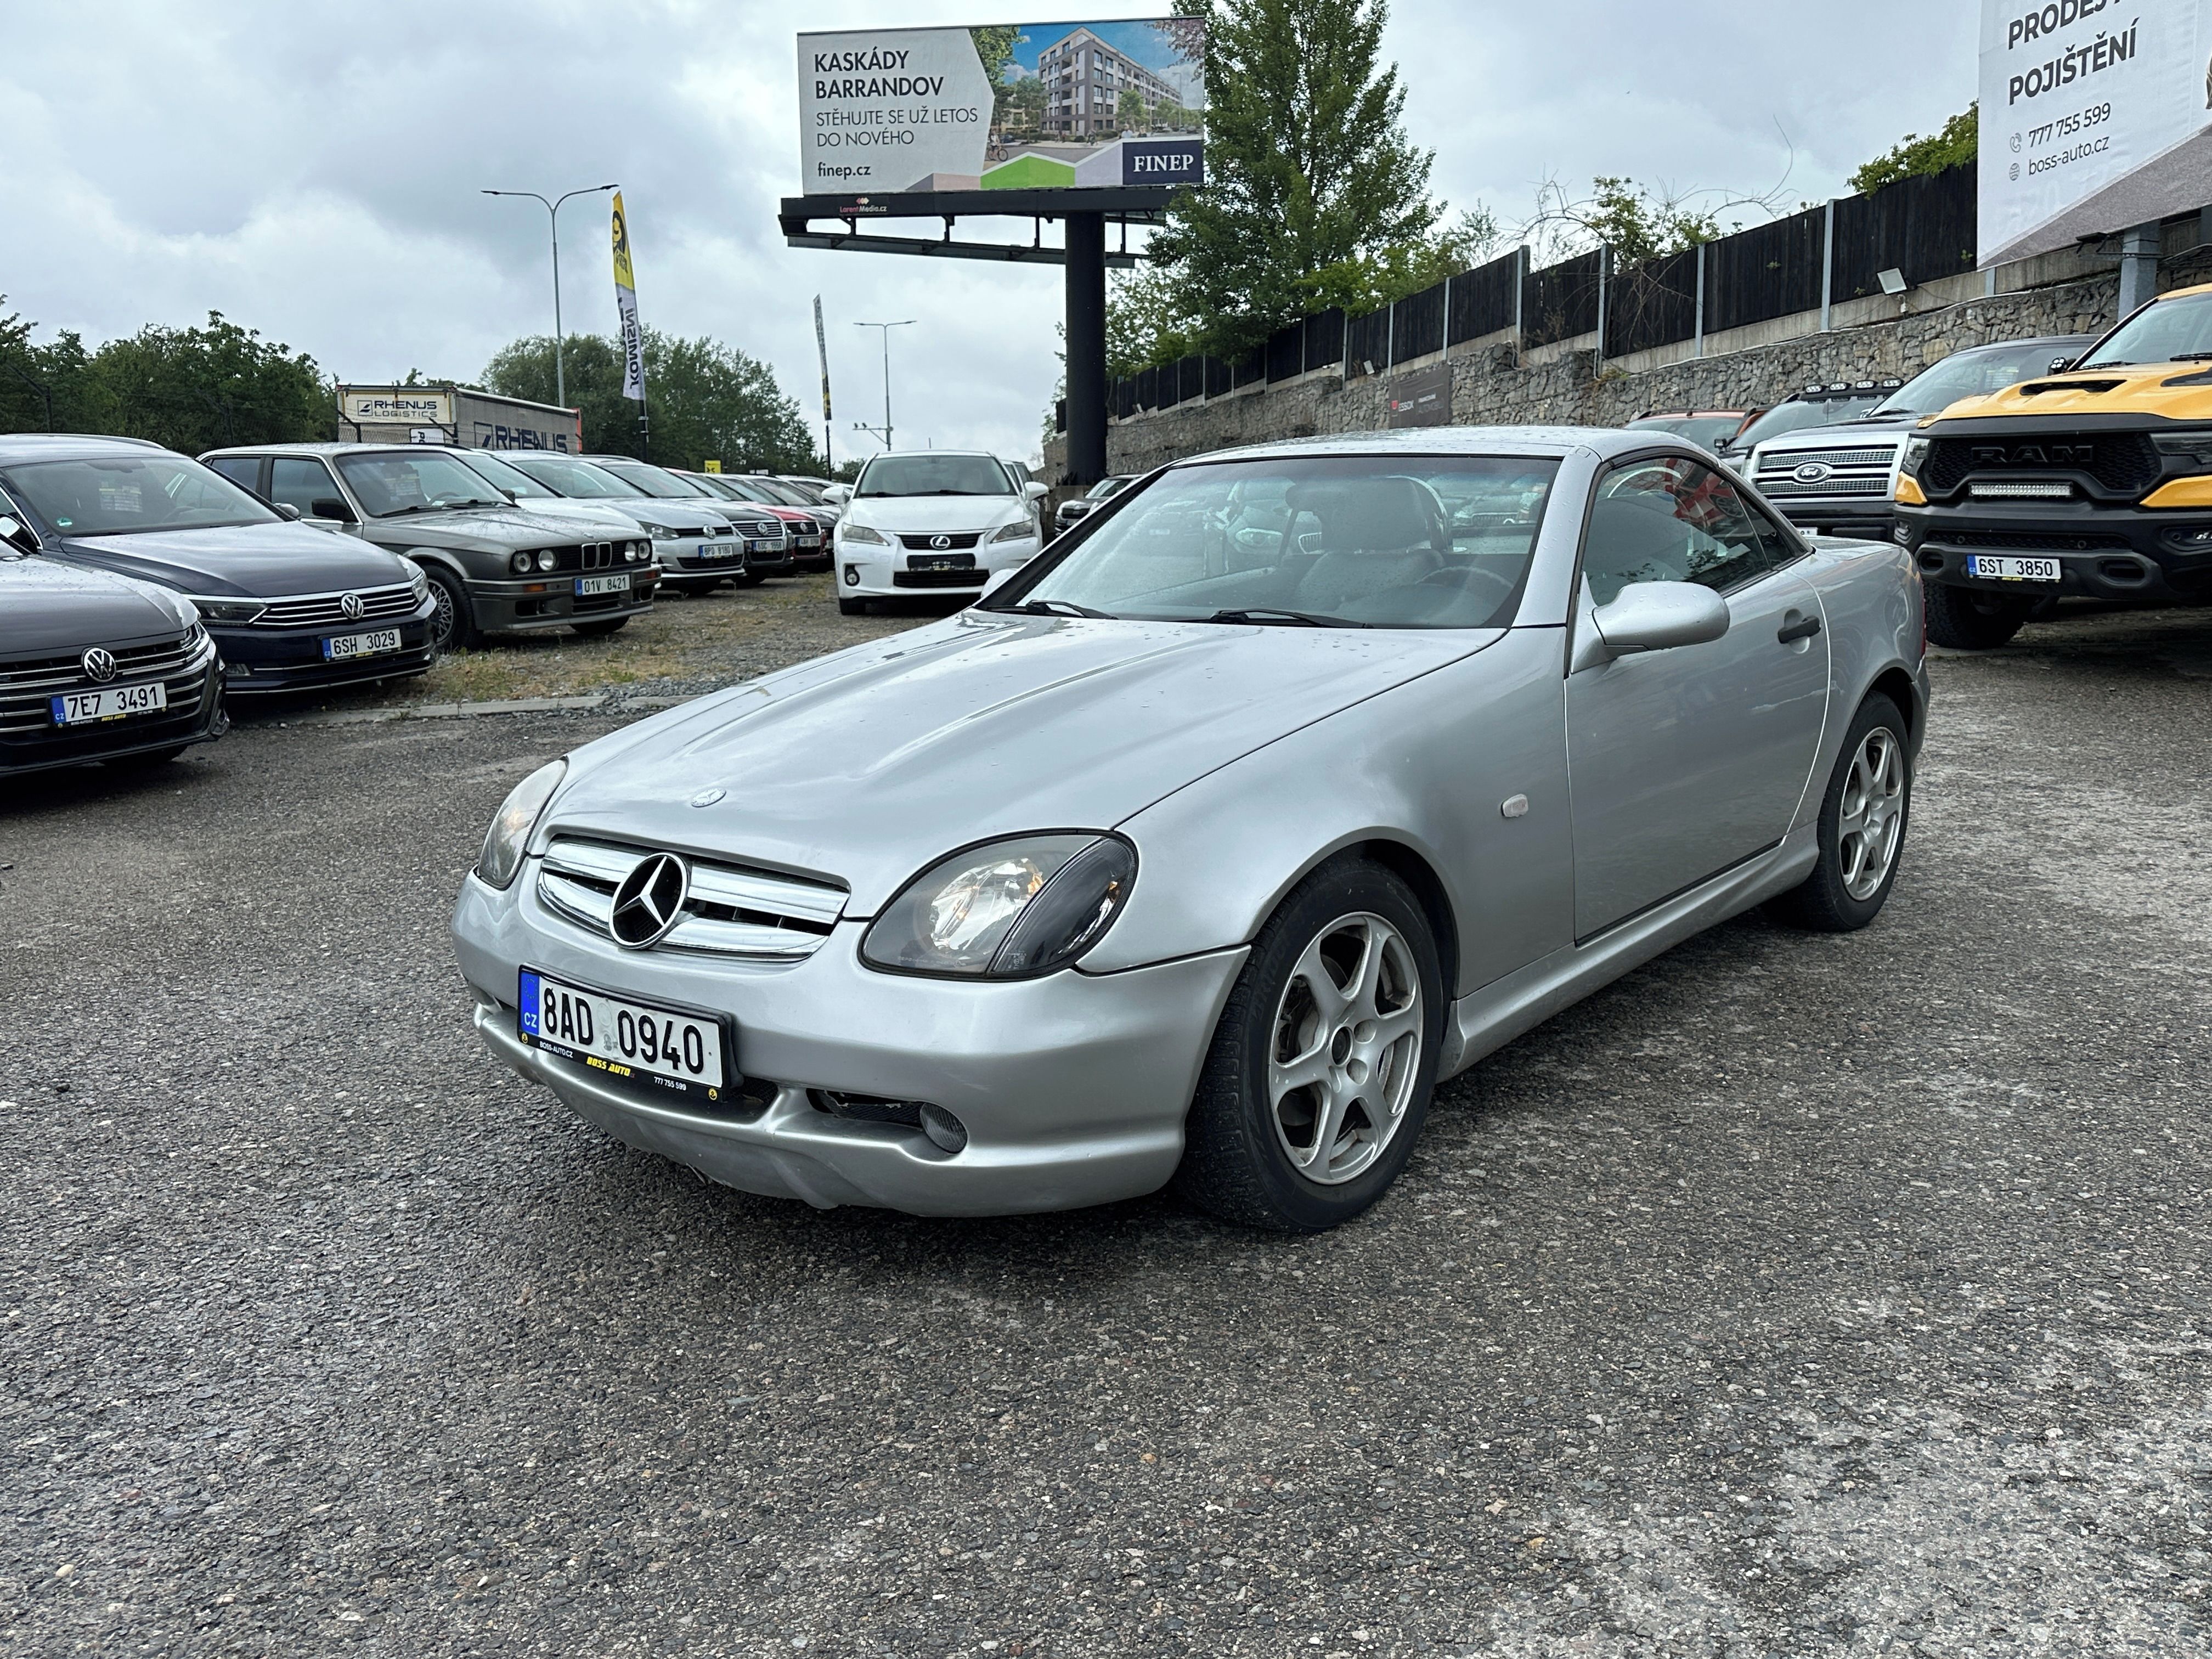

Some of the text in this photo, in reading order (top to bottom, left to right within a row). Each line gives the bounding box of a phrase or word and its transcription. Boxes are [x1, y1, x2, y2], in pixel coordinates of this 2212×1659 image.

[815, 46, 909, 72] KASKÁDY
[2009, 16, 2140, 105] POJIŠTĚNÍ
[816, 77, 944, 99] BARRANDOV
[816, 105, 978, 126] STĚHUJTE SE UŽ LETOS
[2029, 102, 2111, 148] 777 755 599
[817, 127, 915, 147] DO NOVÉHO
[1133, 154, 1194, 173] FINEP
[2029, 136, 2109, 176] boss-auto.cz
[818, 162, 871, 180] finep.cz
[374, 400, 437, 409] RHENUS
[374, 409, 438, 417] LOGISTICS
[495, 425, 568, 454] RHENUS
[1971, 445, 2093, 462] RAM
[1979, 558, 2053, 576] 6ST 3850
[584, 577, 627, 592] 01V 8421
[334, 631, 395, 654] 6SH 3029
[67, 686, 157, 718] 7E7 3491
[524, 1012, 537, 1028] CZ
[544, 988, 704, 1075] 8AD 0940
[540, 1041, 573, 1058] BOSS-AUTO.CZ
[586, 1056, 607, 1069] BOSS
[608, 1063, 631, 1077] AUTO
[654, 1076, 686, 1091] 777 755 599
